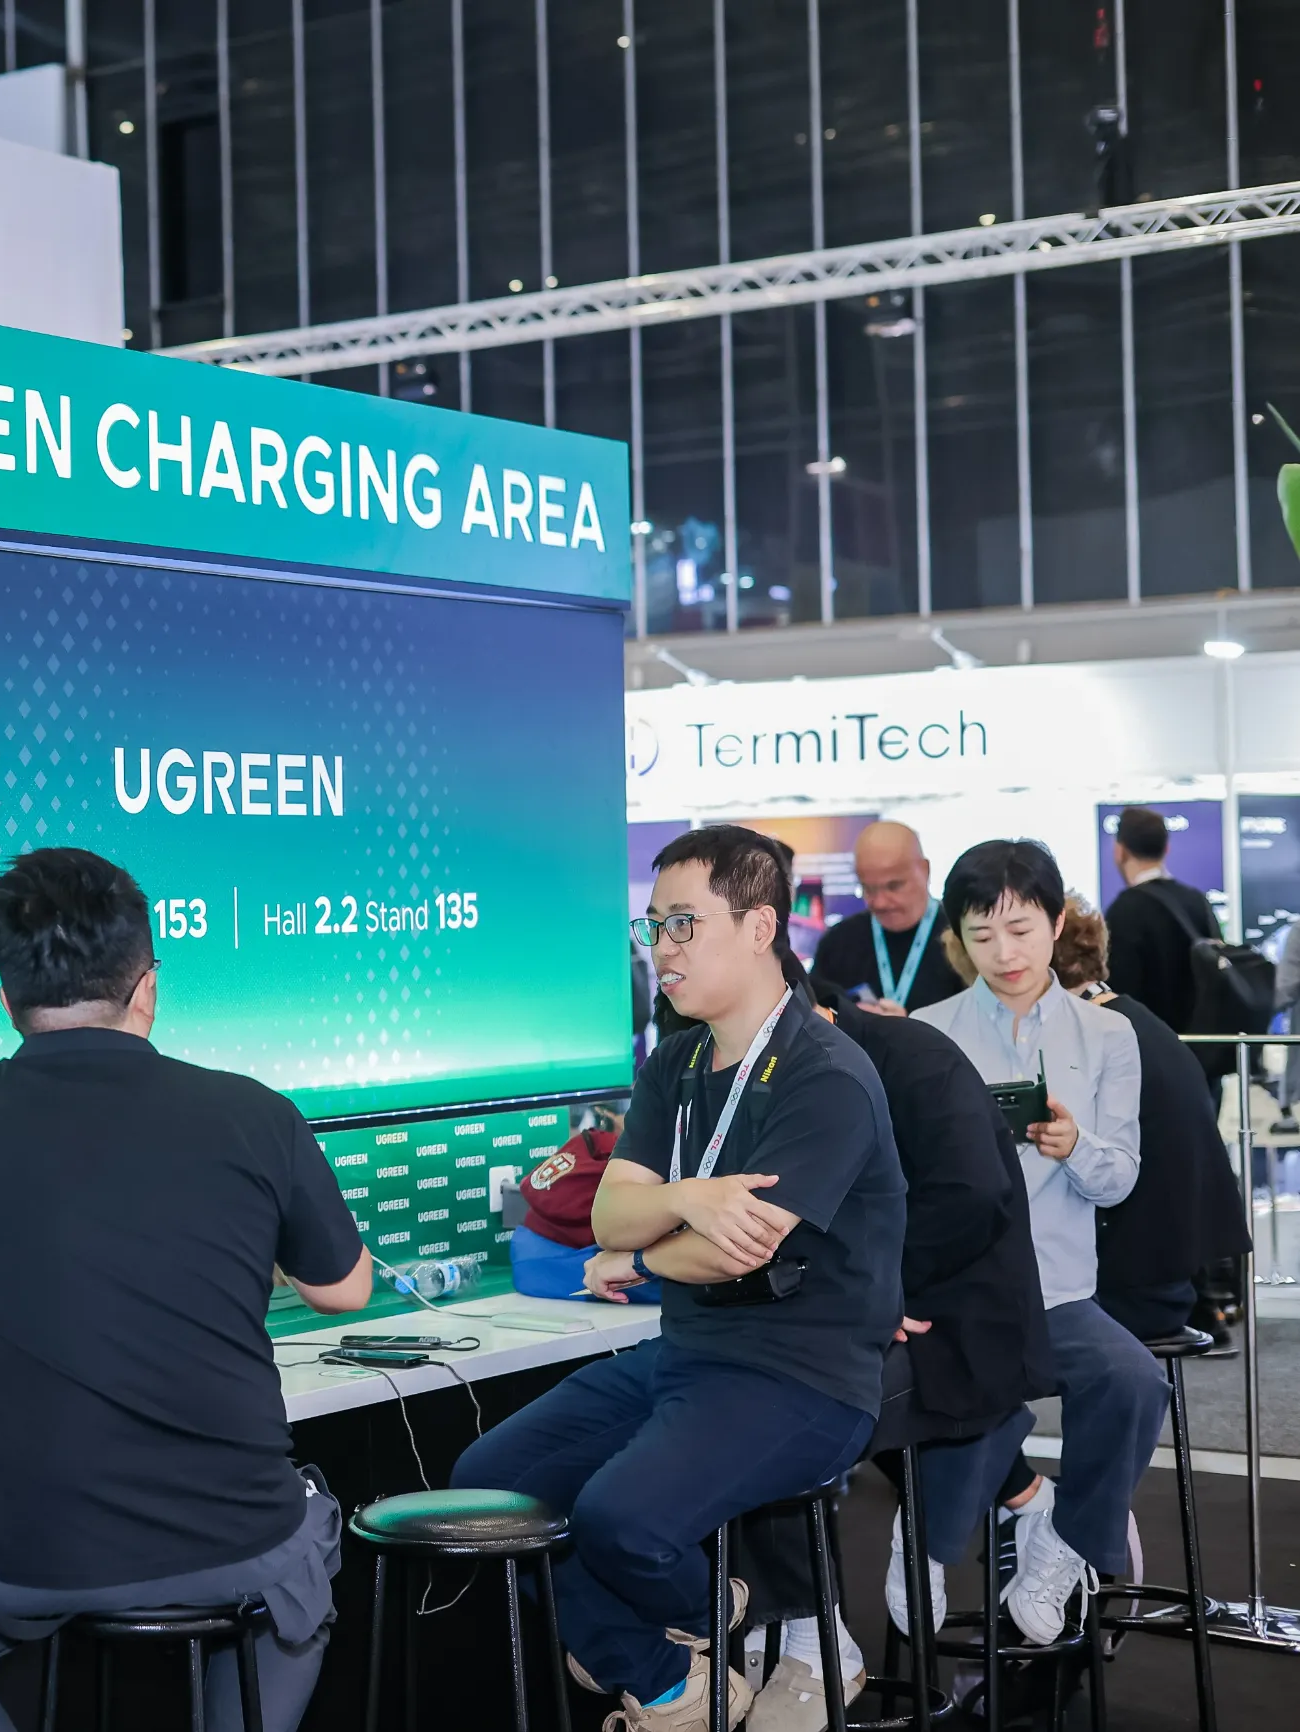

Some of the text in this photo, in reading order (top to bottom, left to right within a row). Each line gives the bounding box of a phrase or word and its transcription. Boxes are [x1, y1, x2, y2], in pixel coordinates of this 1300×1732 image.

[96, 403, 442, 530] CHARGING
[461, 463, 605, 553] AREA
[685, 710, 987, 768] TermiTech
[114, 747, 344, 817] UGREEN
[153, 898, 208, 939] 153
[264, 892, 479, 936] Hall 2.2 Stand 135
[737, 1064, 750, 1081] TCL
[760, 1055, 777, 1083] Nikon
[529, 1114, 557, 1127] UGREEN
[455, 1122, 485, 1136] UGREEN
[376, 1131, 408, 1145] UGREEN
[493, 1134, 522, 1147] UGREEN
[710, 1133, 723, 1150] TCL
[417, 1144, 448, 1158] UGREEN
[335, 1153, 368, 1167] UGREEN
[455, 1154, 486, 1168] UGREEN
[377, 1164, 409, 1179] UGREEN
[417, 1176, 448, 1190] UGREEN
[341, 1187, 369, 1200] GREEN
[456, 1186, 487, 1201] UGREEN
[378, 1198, 409, 1212] UGREEN
[418, 1208, 449, 1223] UGREEN
[457, 1219, 488, 1233] UGREEN
[378, 1231, 411, 1246] UGREEN
[418, 1241, 450, 1256] UGREEN
